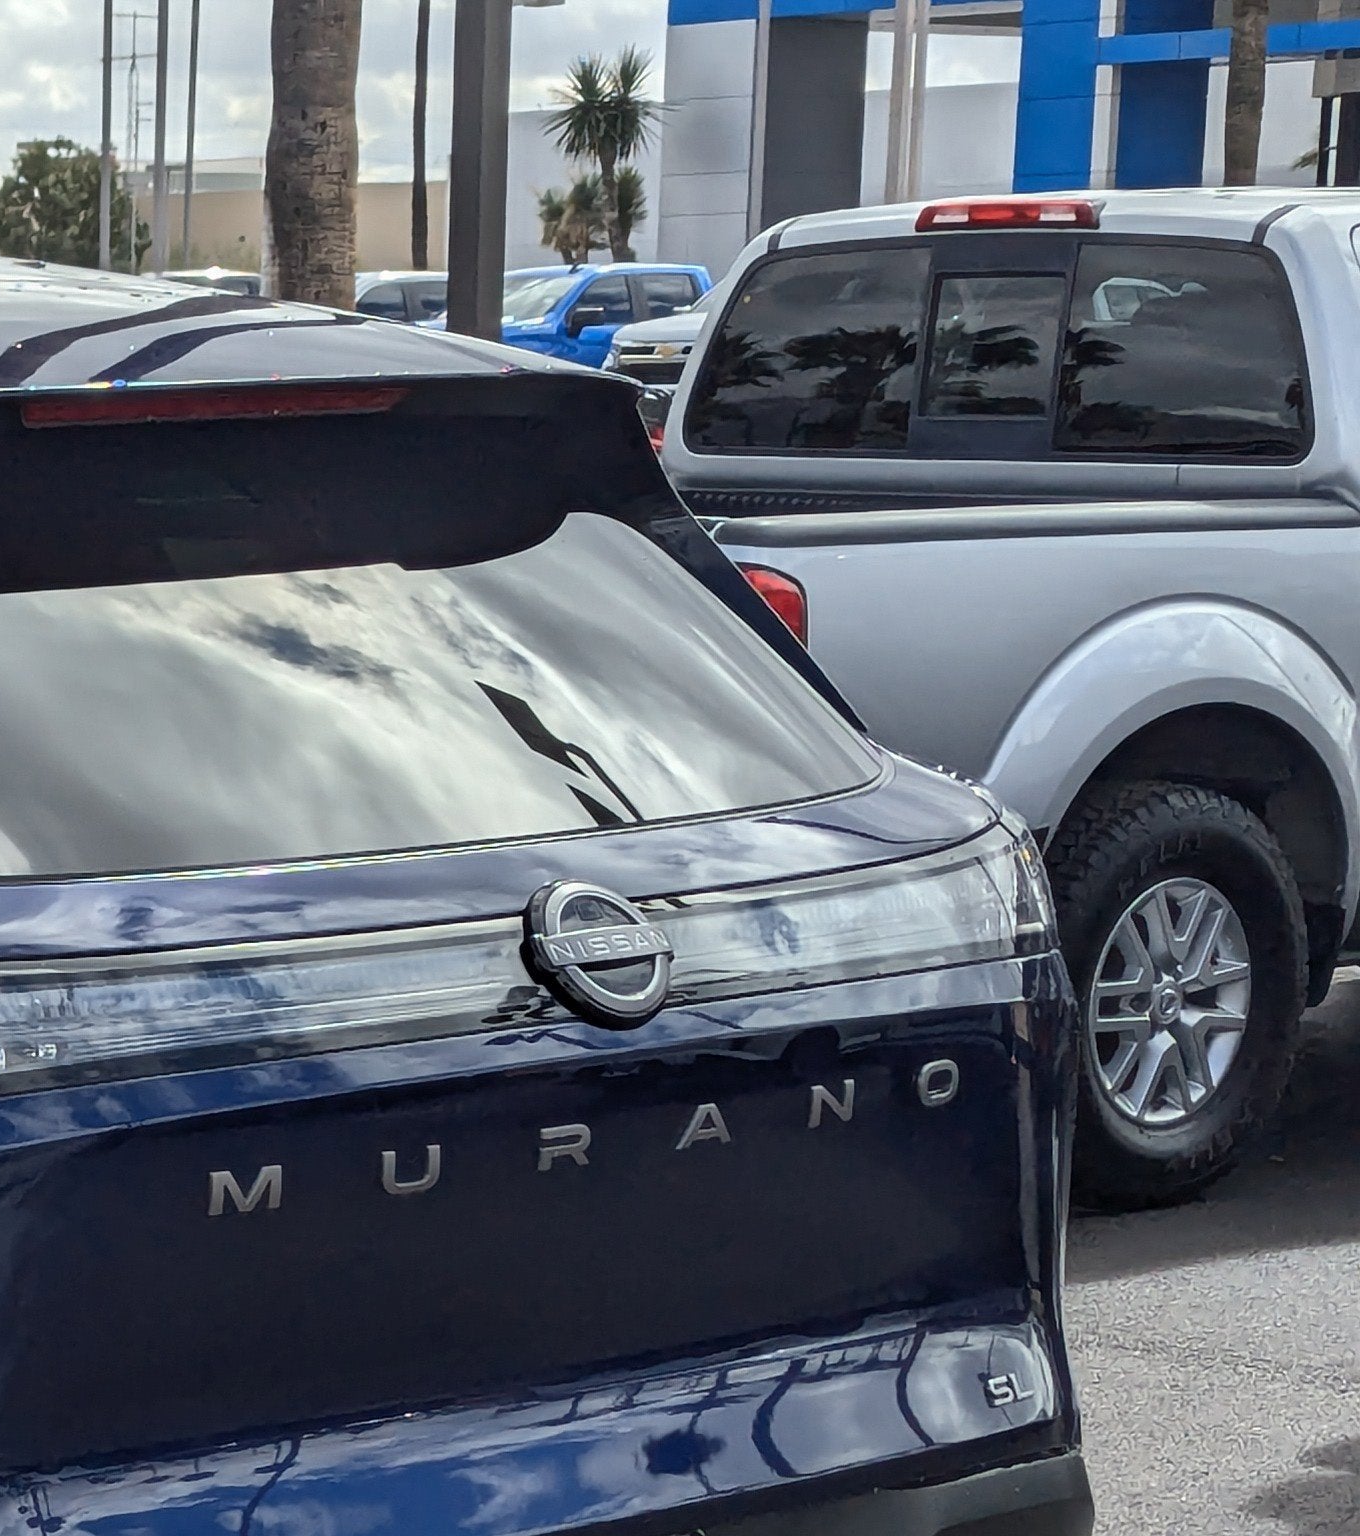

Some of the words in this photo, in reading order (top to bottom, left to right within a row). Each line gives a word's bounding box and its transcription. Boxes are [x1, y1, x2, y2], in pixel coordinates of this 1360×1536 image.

[548, 929, 670, 962] NISSAN
[207, 1059, 960, 1216] MURANO
[987, 1373, 1035, 1406] SL
